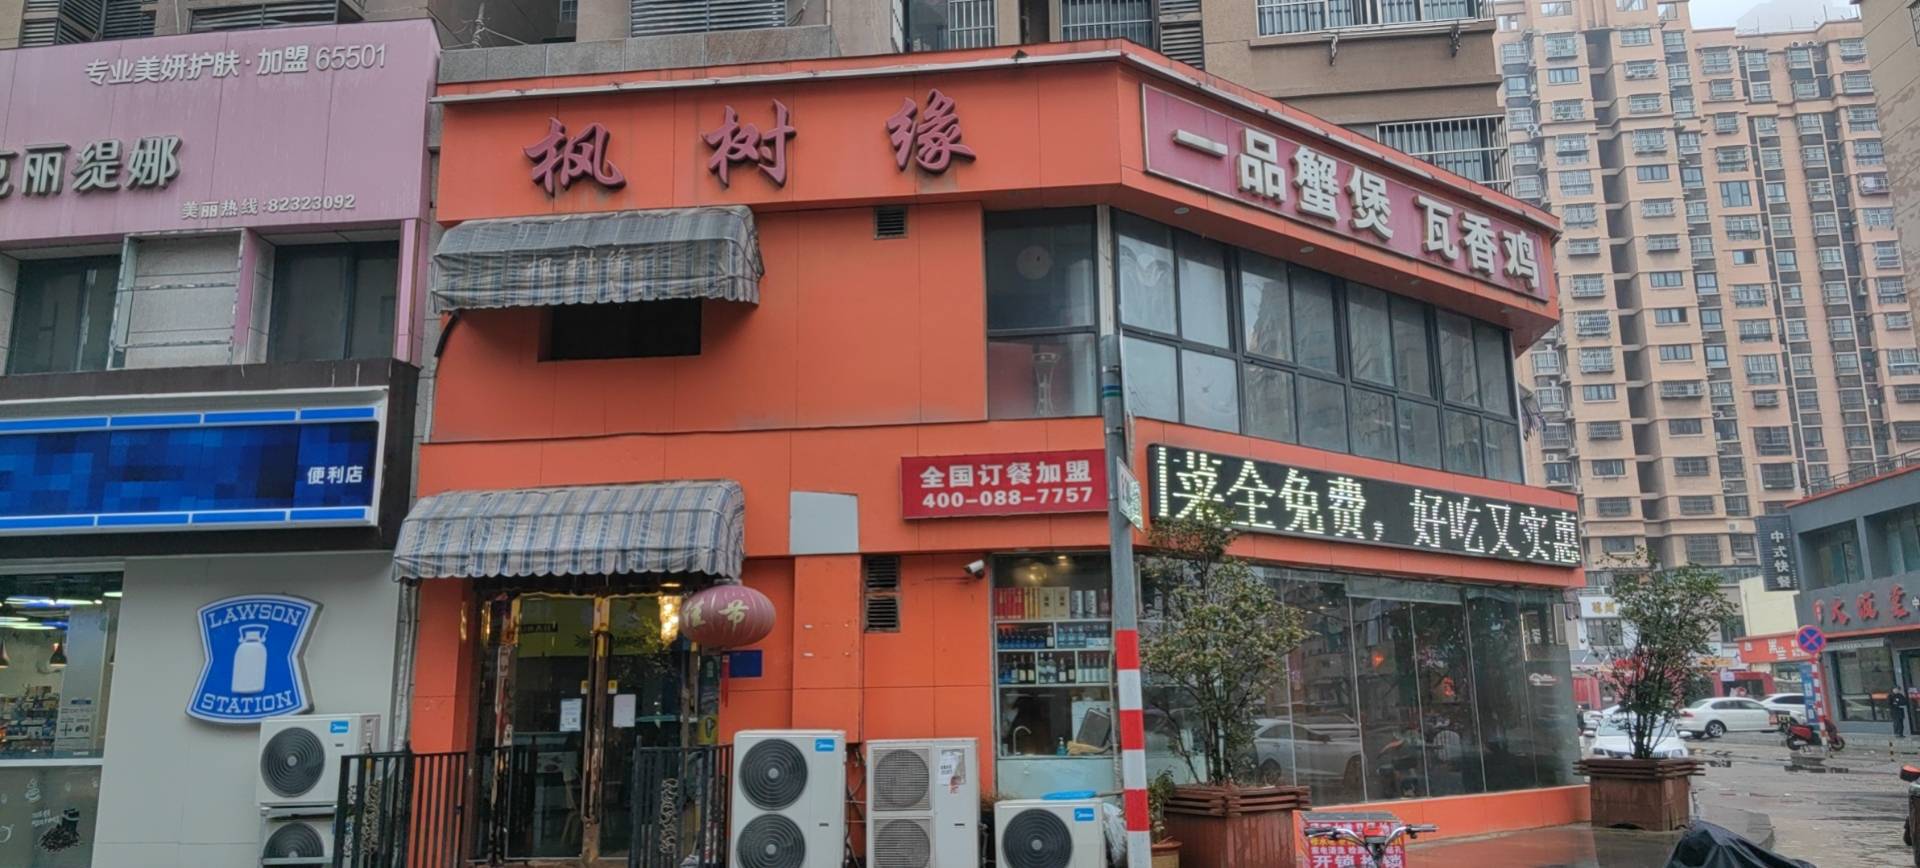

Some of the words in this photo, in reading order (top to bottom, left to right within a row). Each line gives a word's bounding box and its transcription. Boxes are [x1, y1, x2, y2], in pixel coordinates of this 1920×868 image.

[315, 43, 387, 71] 65501
[523, 89, 977, 197] 枫树缘
[1173, 127, 1394, 240] 一品蟹煲
[1416, 194, 1539, 290] 瓦香鸡
[307, 465, 364, 485] 便利店
[919, 459, 1092, 489] 全国订餐加盟
[922, 486, 1093, 509] 400-088-7757
[1770, 530, 1792, 588] 中式快餐
[208, 603, 303, 629] LAWSON
[201, 690, 294, 715] STATION
